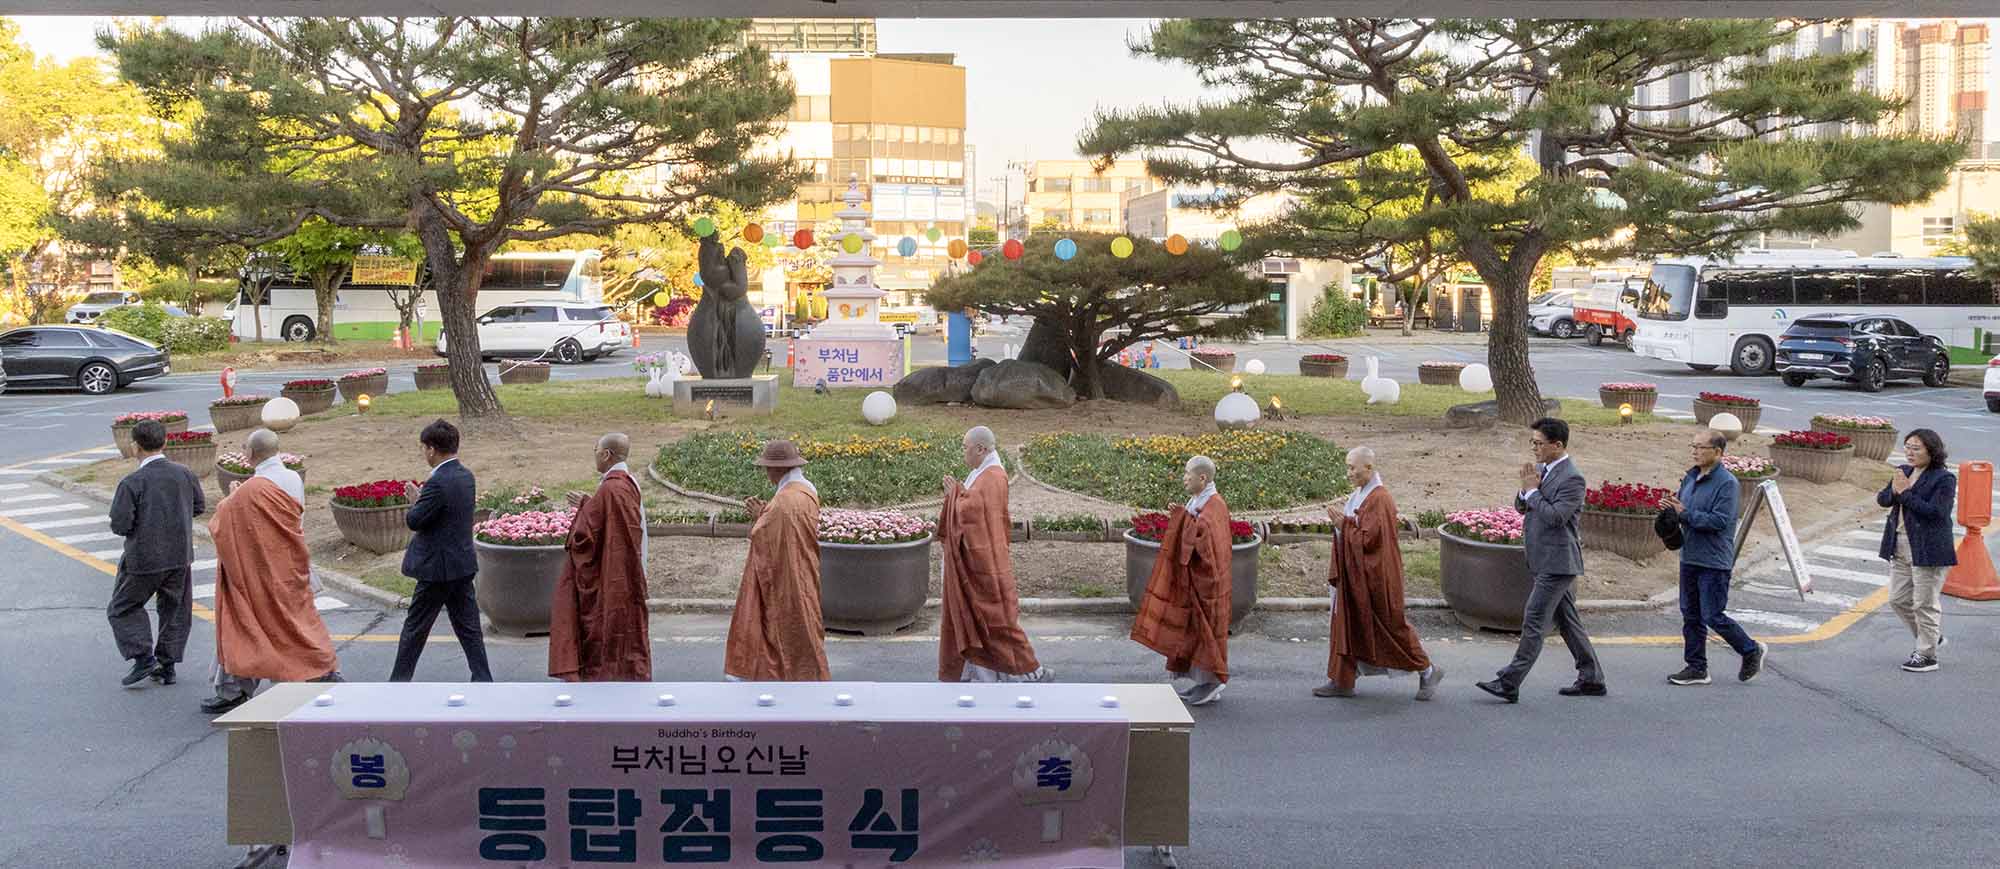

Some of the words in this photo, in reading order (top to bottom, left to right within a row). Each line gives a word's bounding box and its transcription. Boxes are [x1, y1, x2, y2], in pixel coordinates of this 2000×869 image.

[818, 347, 859, 363] 부처님
[827, 367, 883, 382] 품안에서
[658, 728, 708, 738] Buddha's
[711, 728, 757, 740] Birthday
[350, 754, 386, 788] 봉
[611, 744, 810, 776] 부처님오신날
[1037, 757, 1072, 791] 축
[478, 787, 920, 863] 등탑점등식
